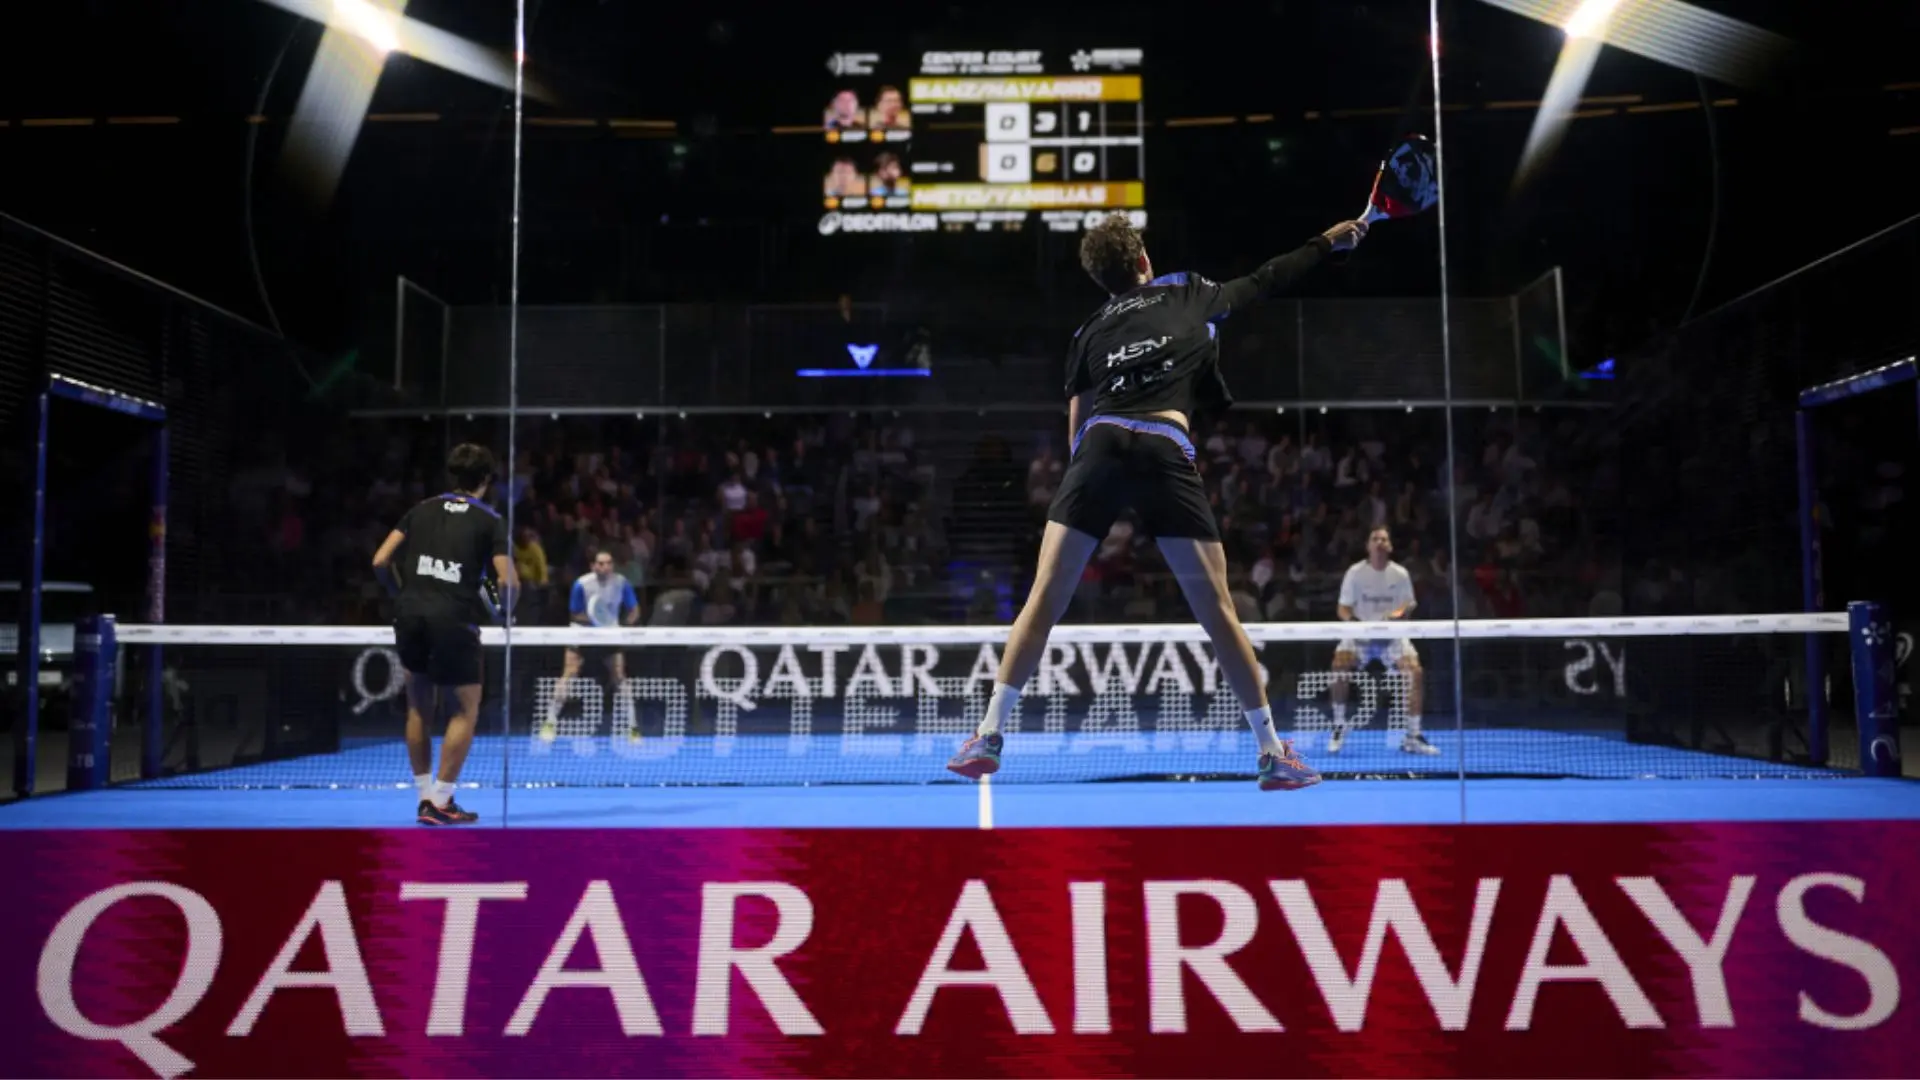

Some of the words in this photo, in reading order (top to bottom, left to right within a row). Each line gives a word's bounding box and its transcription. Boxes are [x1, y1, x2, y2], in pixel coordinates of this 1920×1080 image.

[999, 115, 1017, 131] 0
[1033, 110, 1057, 133] 3
[1077, 110, 1092, 133] 1
[1000, 154, 1018, 171] 0
[1073, 151, 1096, 174] 0
[842, 213, 938, 232] DECATHLON
[700, 643, 944, 711] QATAR
[35, 878, 827, 1080] QATAR
[894, 871, 1901, 1036] AIRWAYS
